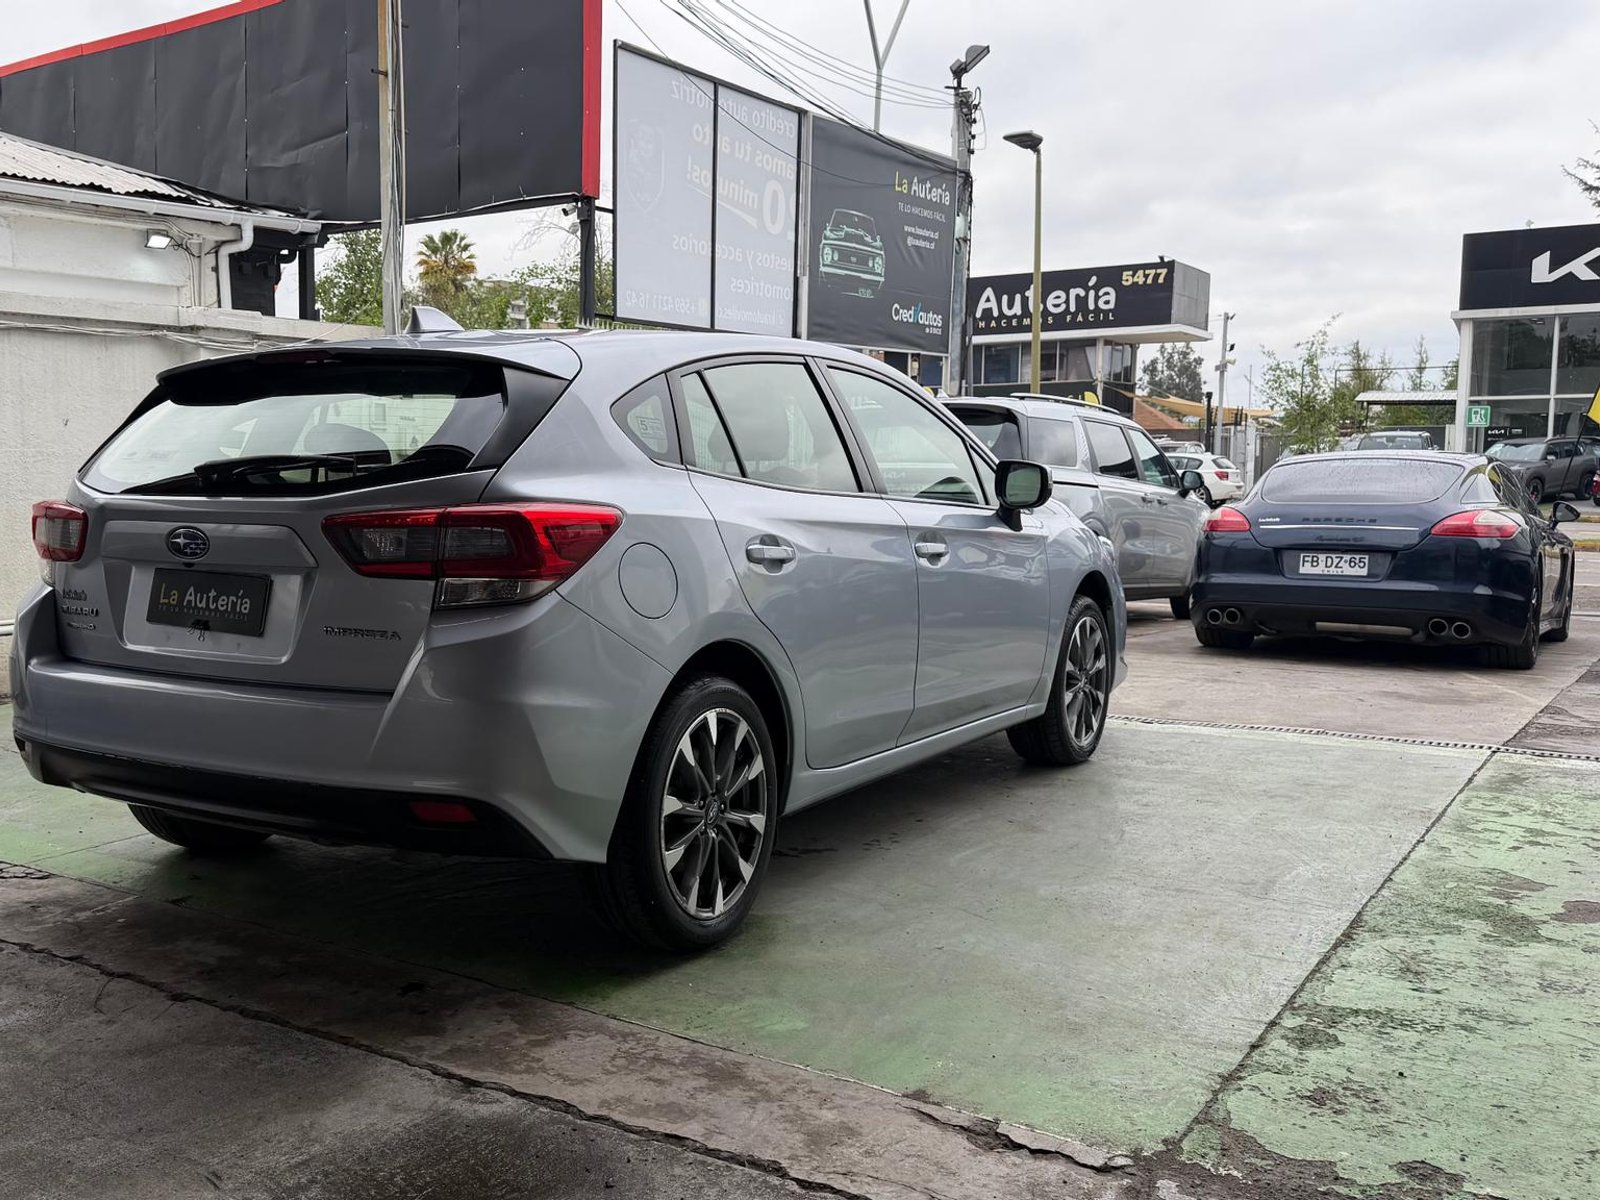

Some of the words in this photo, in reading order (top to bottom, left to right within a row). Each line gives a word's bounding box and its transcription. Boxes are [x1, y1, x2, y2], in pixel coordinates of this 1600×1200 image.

[895, 170, 908, 193] La
[911, 176, 950, 206] Autería
[1122, 268, 1168, 286] 5477
[975, 275, 1116, 319] Autería
[978, 316, 1053, 329] HACEMS
[1066, 312, 1115, 323] FÁCIL
[159, 583, 178, 605] La
[183, 585, 250, 614] Autería
